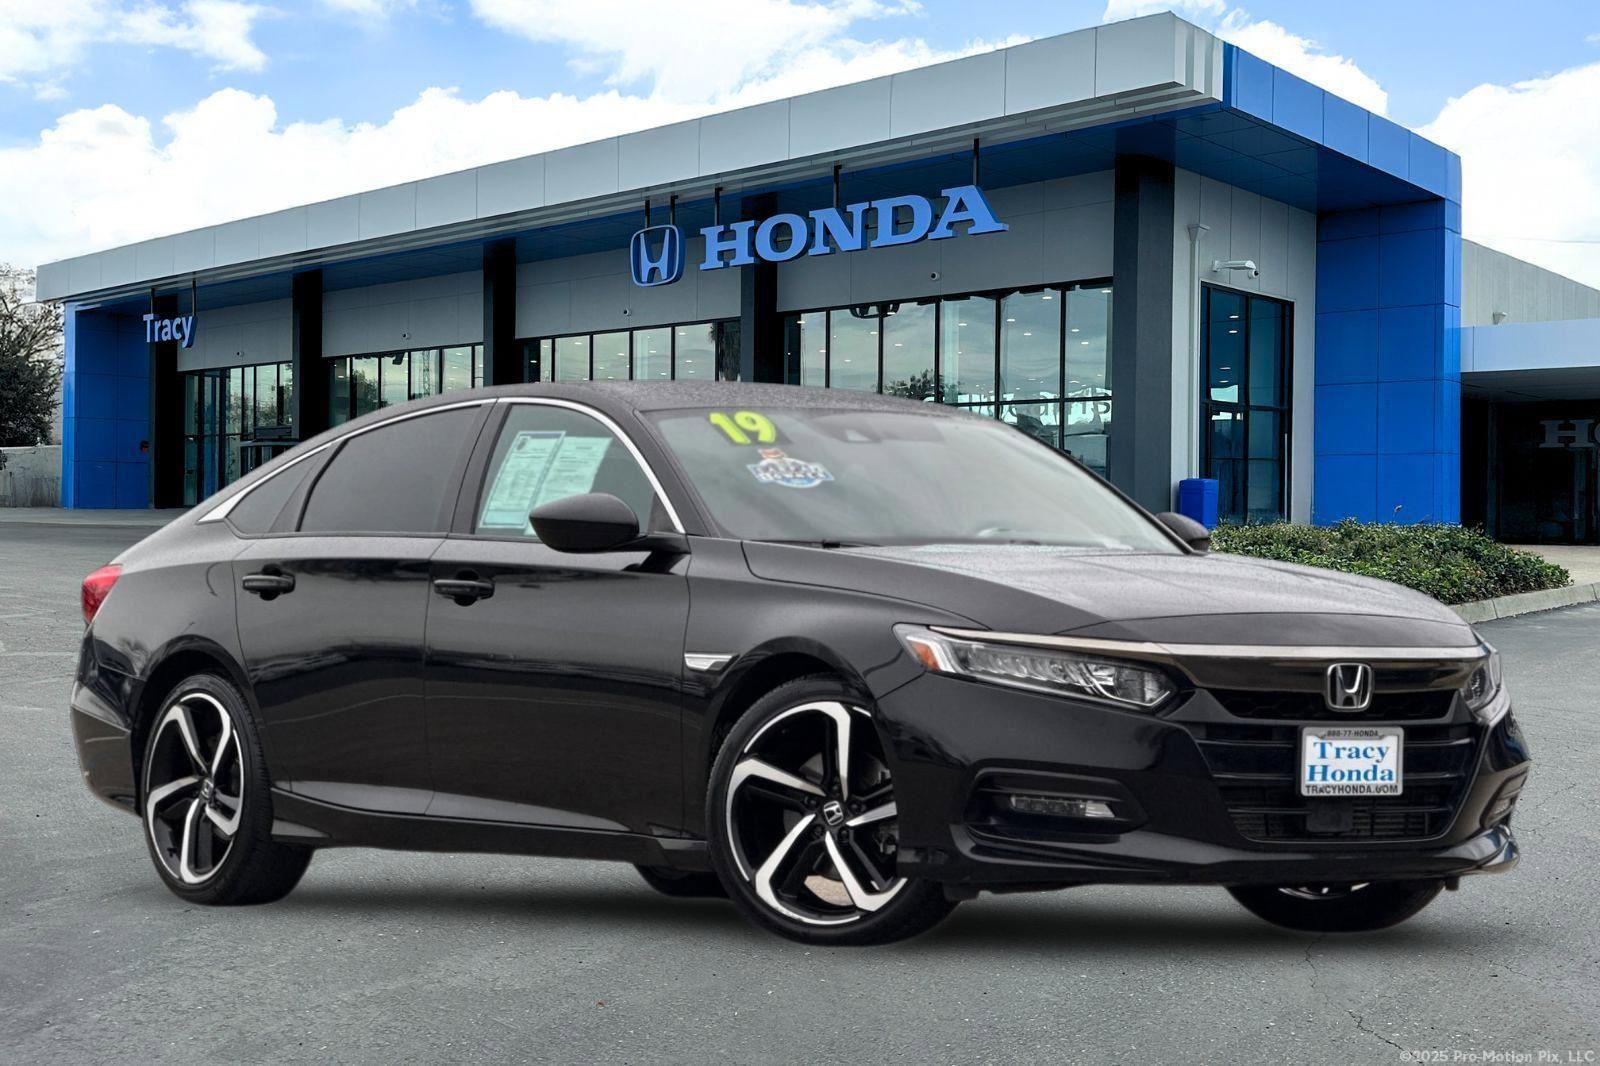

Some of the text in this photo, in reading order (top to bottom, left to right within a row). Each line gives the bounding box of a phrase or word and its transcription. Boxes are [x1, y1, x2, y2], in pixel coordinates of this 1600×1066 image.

[700, 185, 1009, 270] HONDA
[143, 313, 194, 348] Tracy
[709, 411, 776, 445] 19
[1539, 419, 1600, 448] H
[1313, 742, 1390, 763] Tracy
[1308, 764, 1393, 782] Honda
